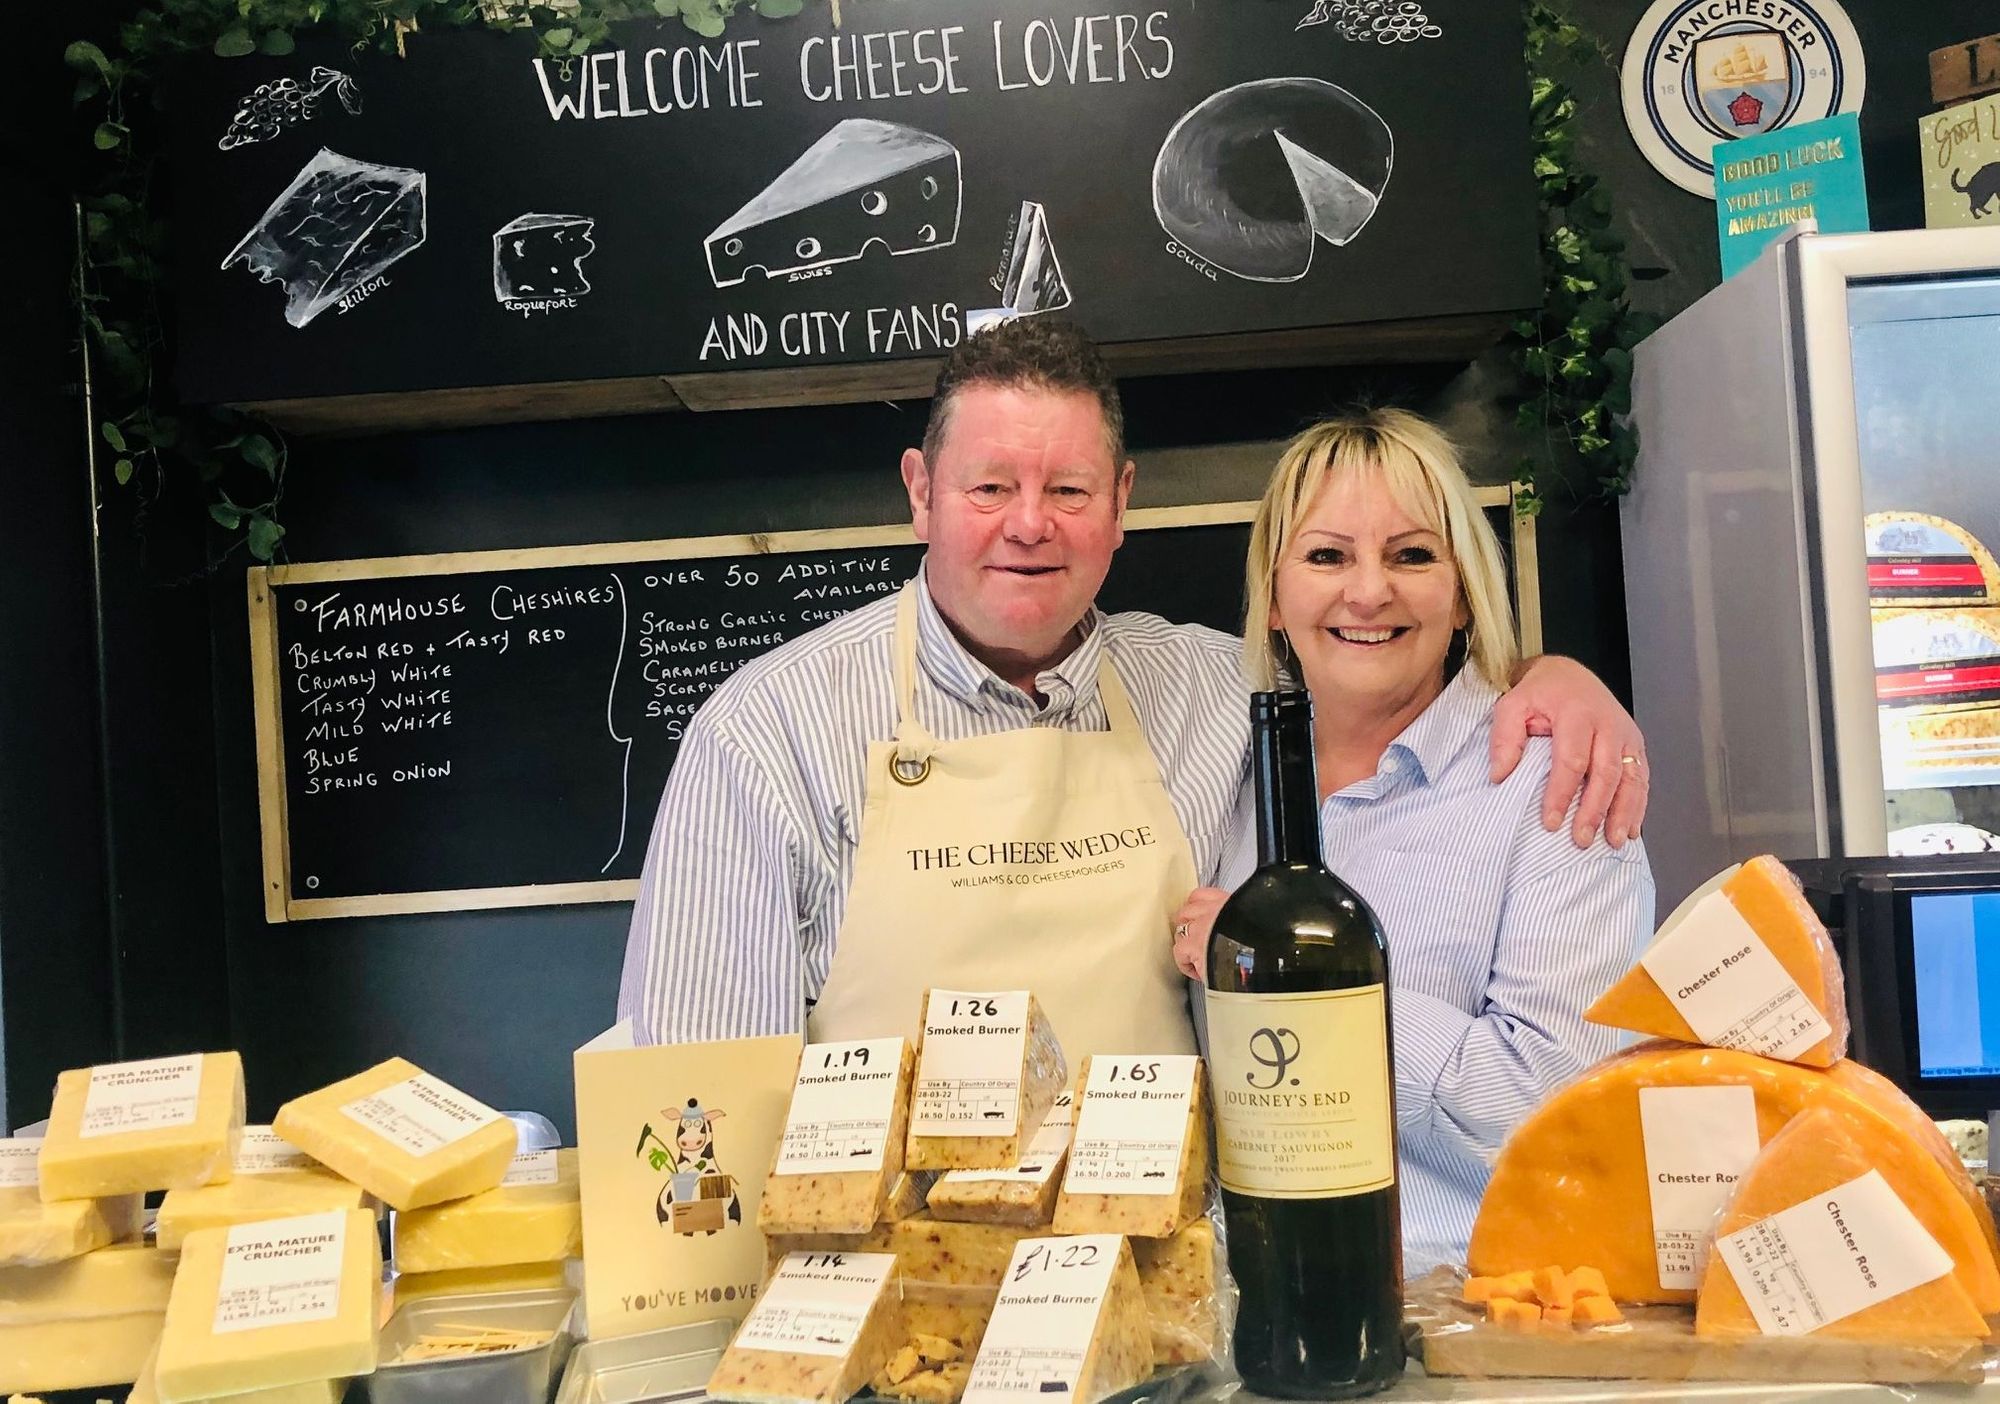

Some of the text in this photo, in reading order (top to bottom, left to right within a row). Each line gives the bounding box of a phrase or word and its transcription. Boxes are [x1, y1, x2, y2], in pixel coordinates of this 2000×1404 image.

[1664, 0, 1816, 64] MANCHESTER
[533, 11, 1174, 121] WELCOME CHEESE LOVERS
[1808, 67, 1827, 79] 94
[1660, 85, 1676, 96] 18
[1934, 106, 1980, 169] Good
[1785, 136, 1844, 170] LUCK
[1165, 241, 1217, 282] Gouda
[699, 305, 960, 361] AND CITY FANS
[644, 557, 891, 588] OVER 50 ADDITIVE
[311, 593, 466, 633] FARMHOUSE
[639, 608, 850, 635] STRONG GARLIC CHEDD
[289, 643, 367, 670] BELTON
[378, 643, 413, 660] RED
[446, 630, 509, 655] TASTY
[528, 628, 566, 645] RED
[639, 631, 784, 657] SMOKED BURNER
[297, 664, 453, 694] CRUMBLY WHITE
[643, 658, 752, 683] CARAMELIS
[654, 682, 722, 698] SCORPIO
[301, 690, 451, 723] TASTY WHITE
[645, 700, 696, 717] SAGE
[305, 710, 452, 742] MILD WHITE
[303, 747, 359, 774] BLUE
[305, 760, 451, 794] SPRING ONION
[907, 826, 1156, 871] THE CHEESE WEDGE
[951, 874, 1005, 888] WILLIAMS
[1032, 860, 1126, 885] CHEESEMONGERS
[1678, 944, 1753, 1001] Chester Rose
[951, 999, 998, 1017] 1.26
[927, 1025, 1021, 1036] Smoked Burner
[1790, 1019, 1813, 1037] 2.81
[823, 1047, 870, 1069] 1.19
[92, 1065, 193, 1082] EXTRA MATURE
[107, 1074, 181, 1087] CRUNCHER
[799, 1072, 893, 1085] Smoked Burner
[1110, 1063, 1161, 1083] 1.65
[942, 1081, 951, 1089] By
[961, 1081, 984, 1089] Country
[995, 1081, 1016, 1089] Origin
[1086, 1091, 1186, 1099] Smoked Burner
[408, 1079, 484, 1122] EXTRA MATURE
[411, 1089, 467, 1122] CRUNCHER
[1223, 1089, 1351, 1107] JOURNEY'S END
[1228, 1139, 1353, 1154] CABERNET SAUVIGNON
[1273, 1155, 1296, 1163] 2017
[1658, 1172, 1740, 1183] Chester Ros
[227, 1234, 336, 1254] EXTRA MATURE
[243, 1246, 322, 1261] CRUNCHER
[1755, 1223, 1780, 1261] 28-03-22
[1827, 1200, 1878, 1290] Chester Rose
[803, 1254, 846, 1268] 1.14
[1665, 1264, 1690, 1272] 11.99
[778, 1271, 879, 1284] Smoked Burner
[1735, 1239, 1754, 1264] 11.99
[1771, 1305, 1790, 1329] 2.47
[695, 1283, 759, 1304] MOOVE
[999, 1295, 1098, 1305] Smoked Burner
